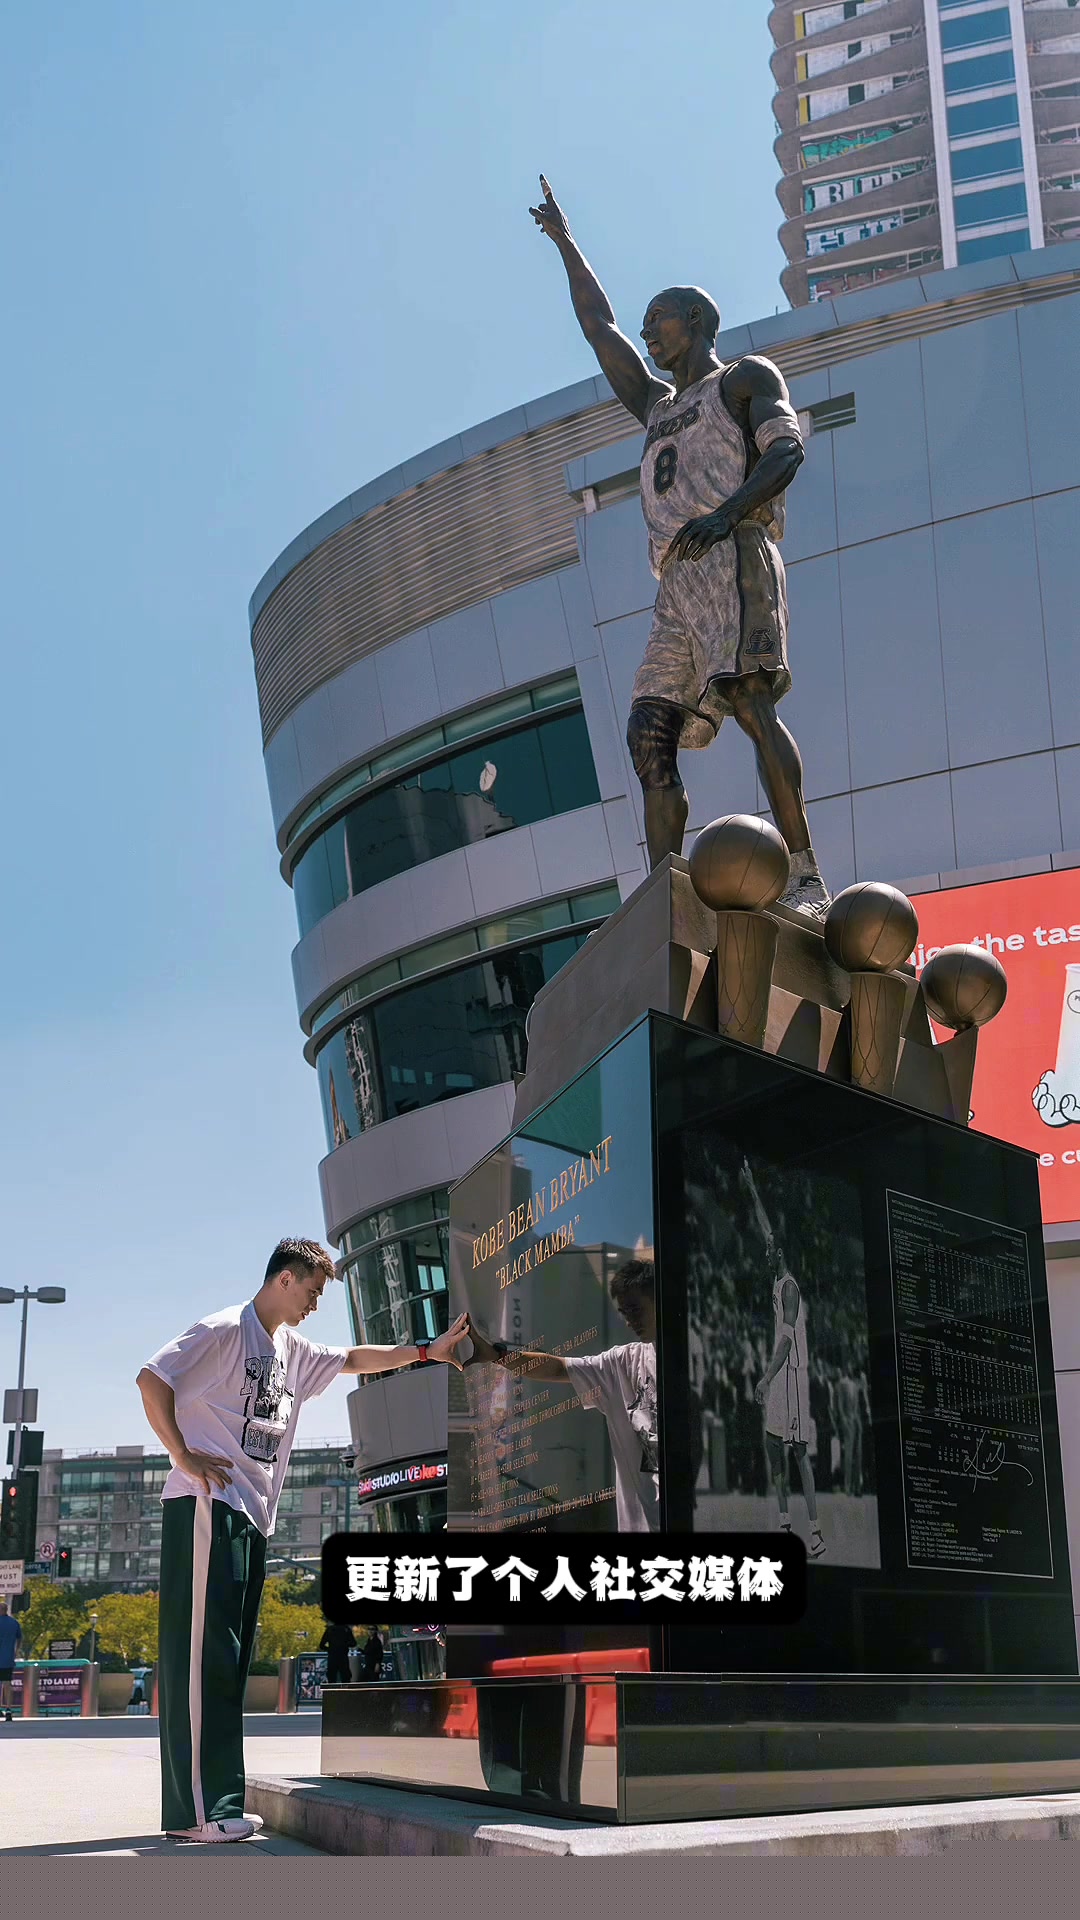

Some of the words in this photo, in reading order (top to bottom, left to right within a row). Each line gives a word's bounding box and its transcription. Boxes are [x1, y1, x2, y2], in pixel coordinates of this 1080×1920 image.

[654, 447, 679, 495] 8
[971, 932, 1026, 954] the
[472, 1218, 505, 1270] KOBE
[508, 1186, 546, 1243] BEAN
[549, 1135, 613, 1213] BRYANT
[573, 1326, 598, 1347] PLAYOFFS
[513, 1398, 531, 1414] STAPLES
[531, 1389, 550, 1406] CENTER
[539, 1399, 571, 1424] THROUGHOUT
[371, 1471, 399, 1490] STUDIO
[518, 1492, 530, 1505] TEAM
